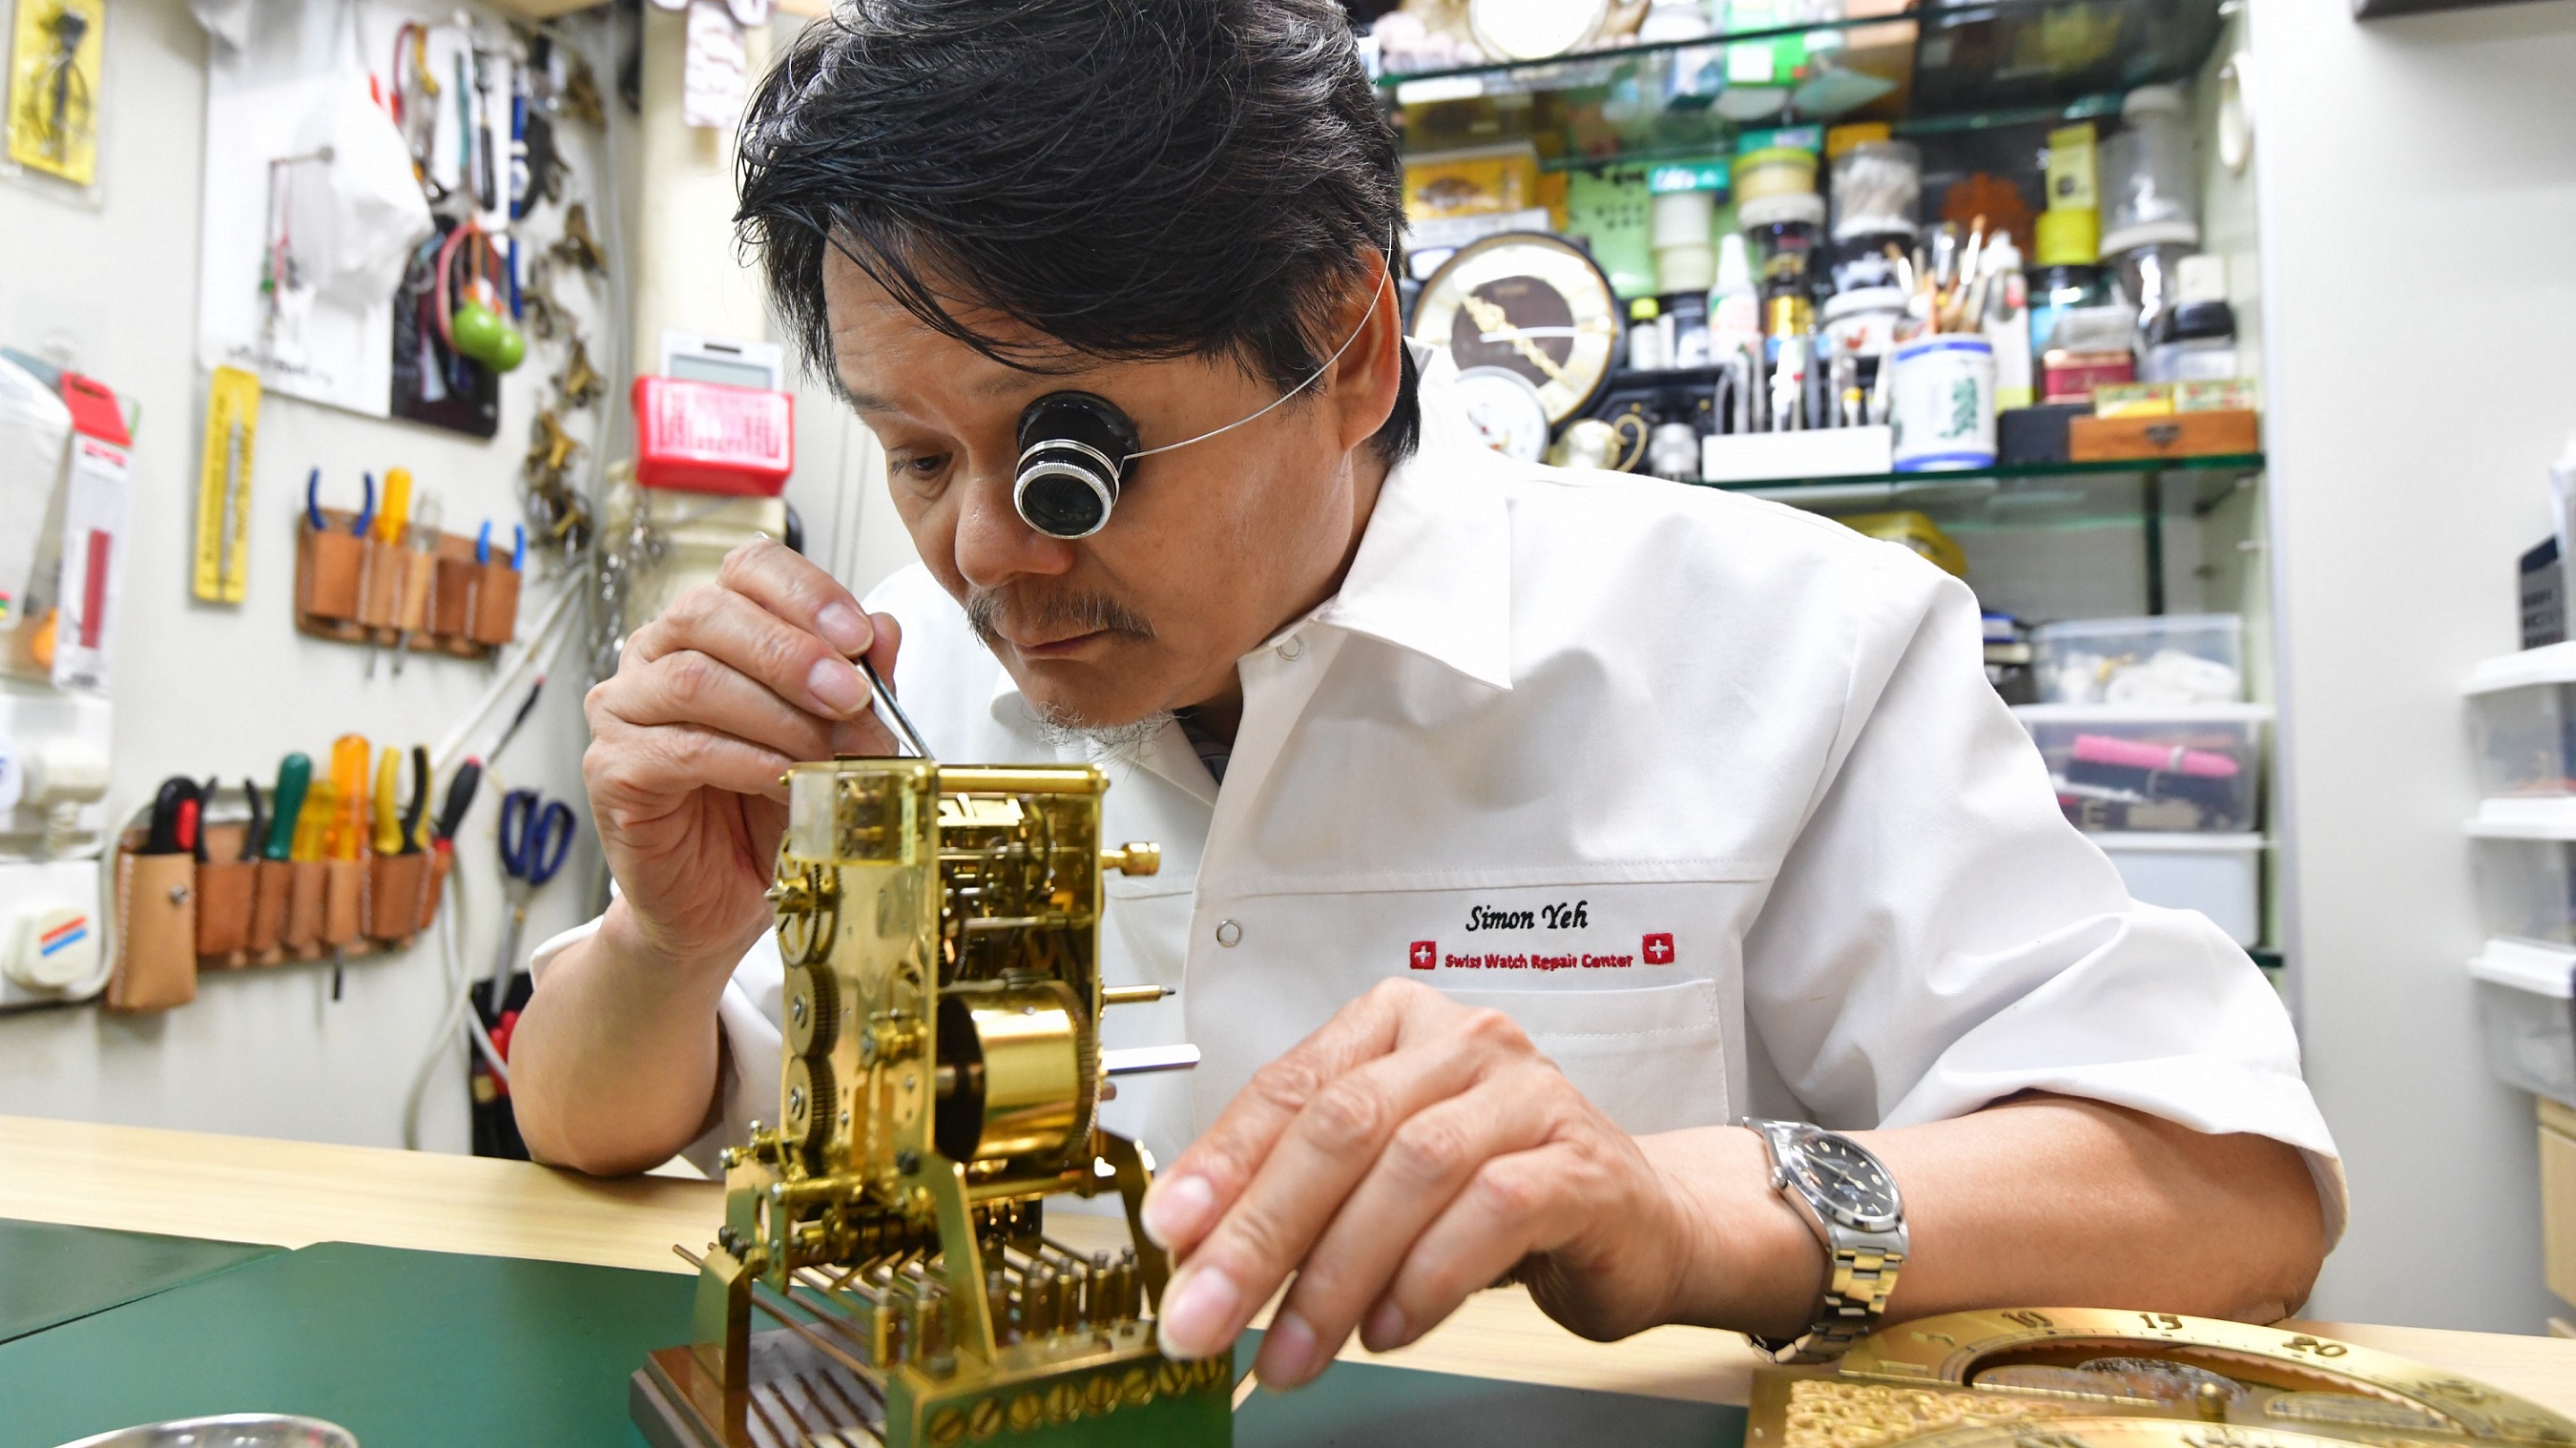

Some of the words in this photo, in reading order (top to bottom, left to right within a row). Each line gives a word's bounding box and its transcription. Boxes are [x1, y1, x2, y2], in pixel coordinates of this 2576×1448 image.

[1465, 905, 1534, 931] Simon
[1542, 901, 1589, 929] Yeh
[1445, 954, 1482, 968] Swiss
[1485, 954, 1527, 968] Watch
[1531, 954, 1577, 971] Repair
[1581, 953, 1633, 968] Center
[2139, 1313, 2183, 1330] 15
[2282, 1335, 2348, 1357] 20
